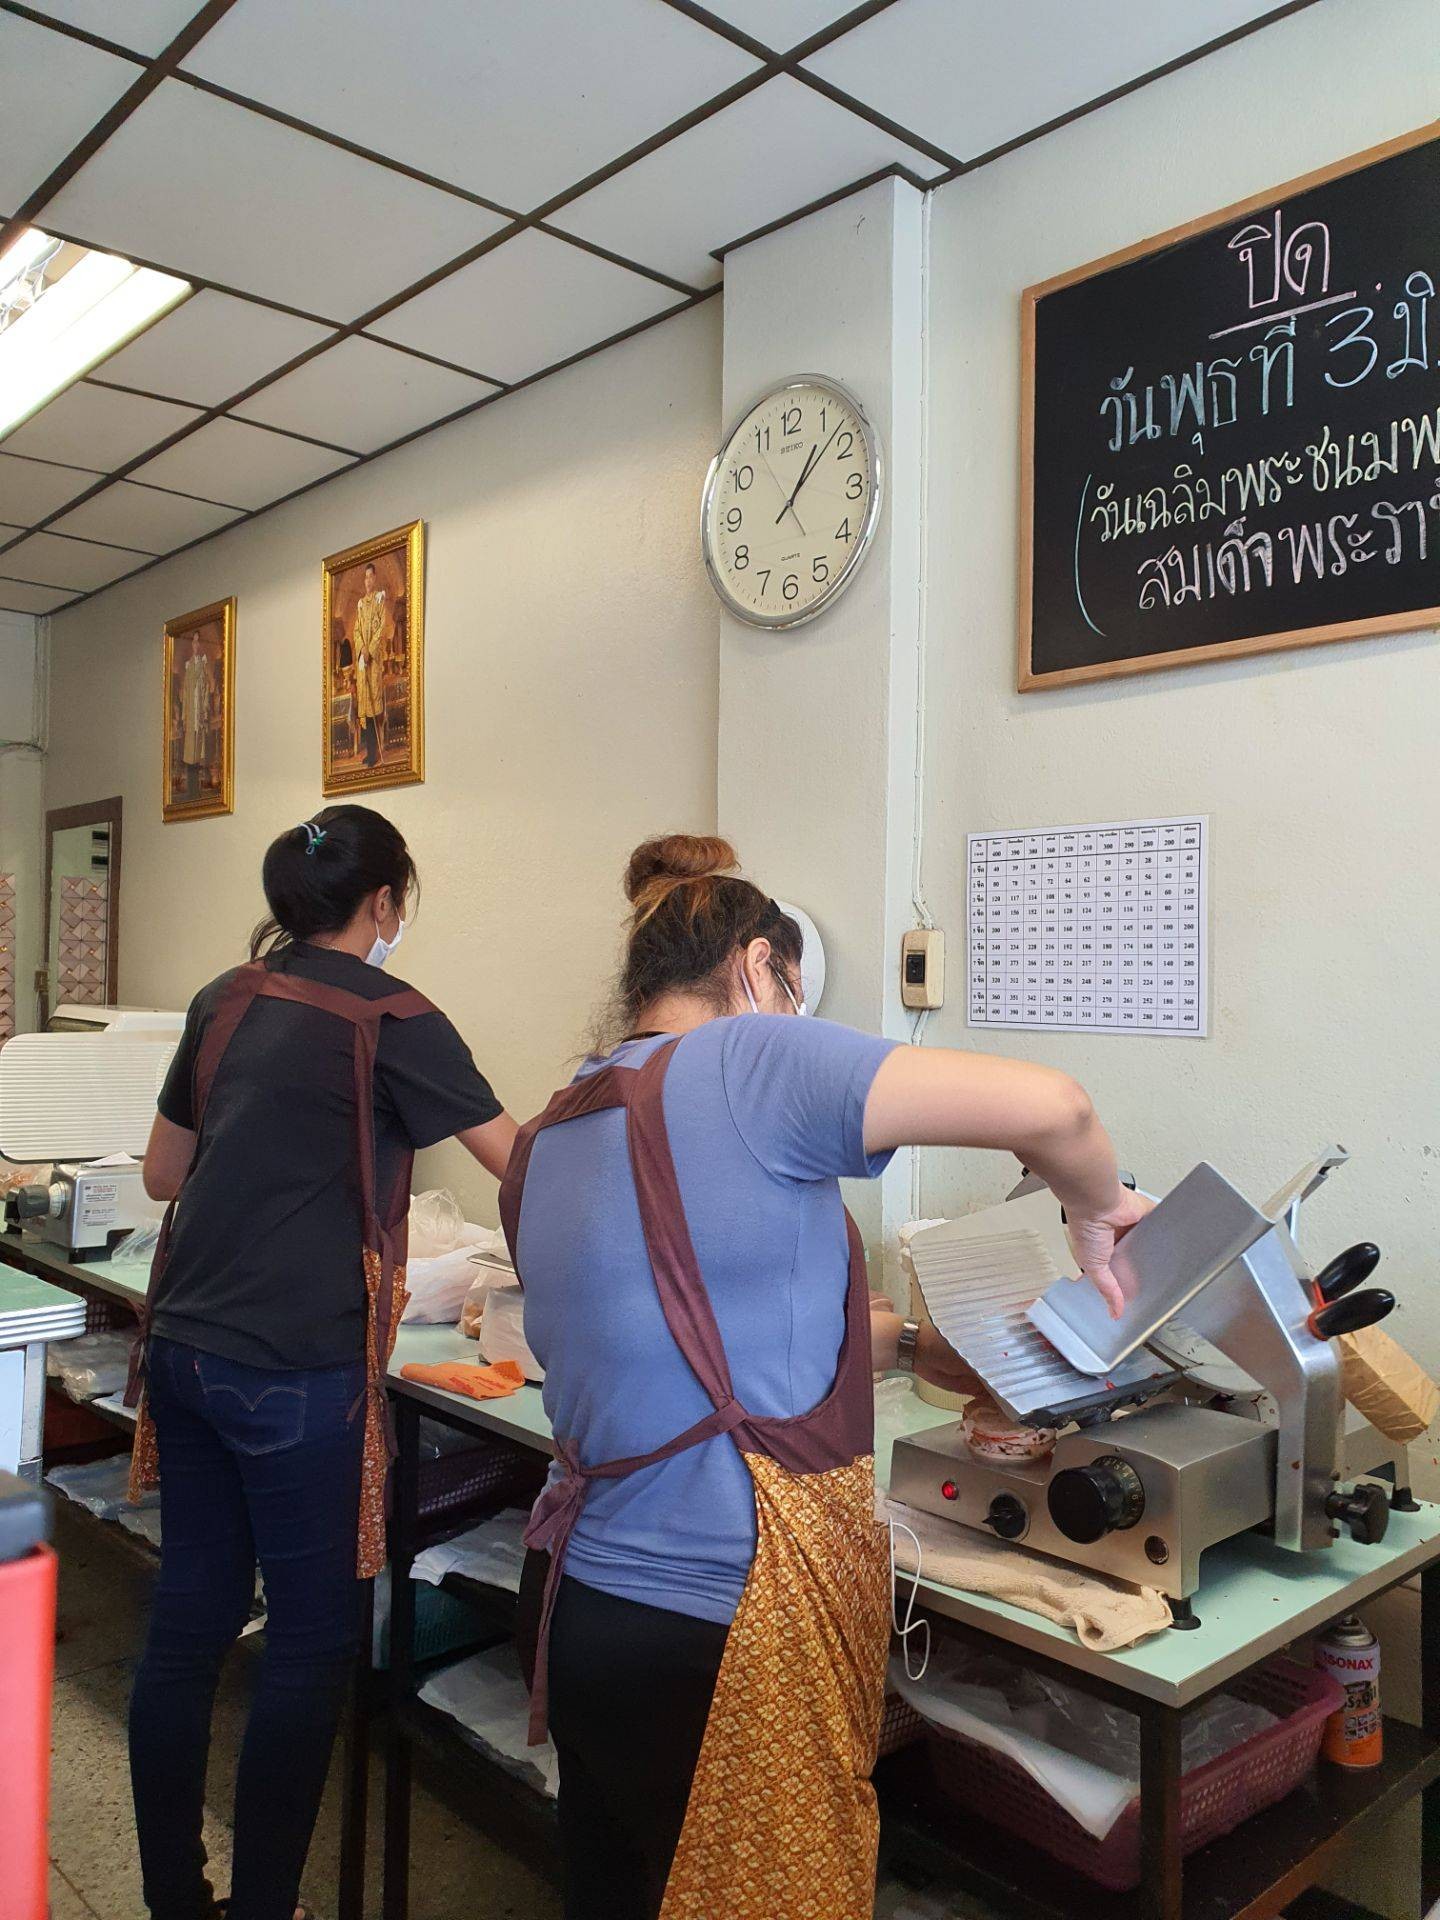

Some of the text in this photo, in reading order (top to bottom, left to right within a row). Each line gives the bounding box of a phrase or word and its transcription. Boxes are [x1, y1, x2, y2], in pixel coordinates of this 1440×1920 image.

[1228, 209, 1330, 308] ปิด
[1325, 306, 1378, 387] 3
[1386, 270, 1440, 379] มิ
[781, 407, 802, 436] 12
[820, 407, 826, 432] 1
[755, 426, 770, 454] 11
[836, 432, 854, 460] 2
[732, 465, 754, 493] 10
[845, 472, 863, 500] 3
[727, 507, 743, 533] 9
[835, 517, 852, 543] 4
[734, 545, 749, 570] 8
[811, 556, 829, 583] 5
[756, 570, 772, 596] 7
[783, 574, 799, 600] 6
[1327, 1655, 1373, 1670] SONAX
